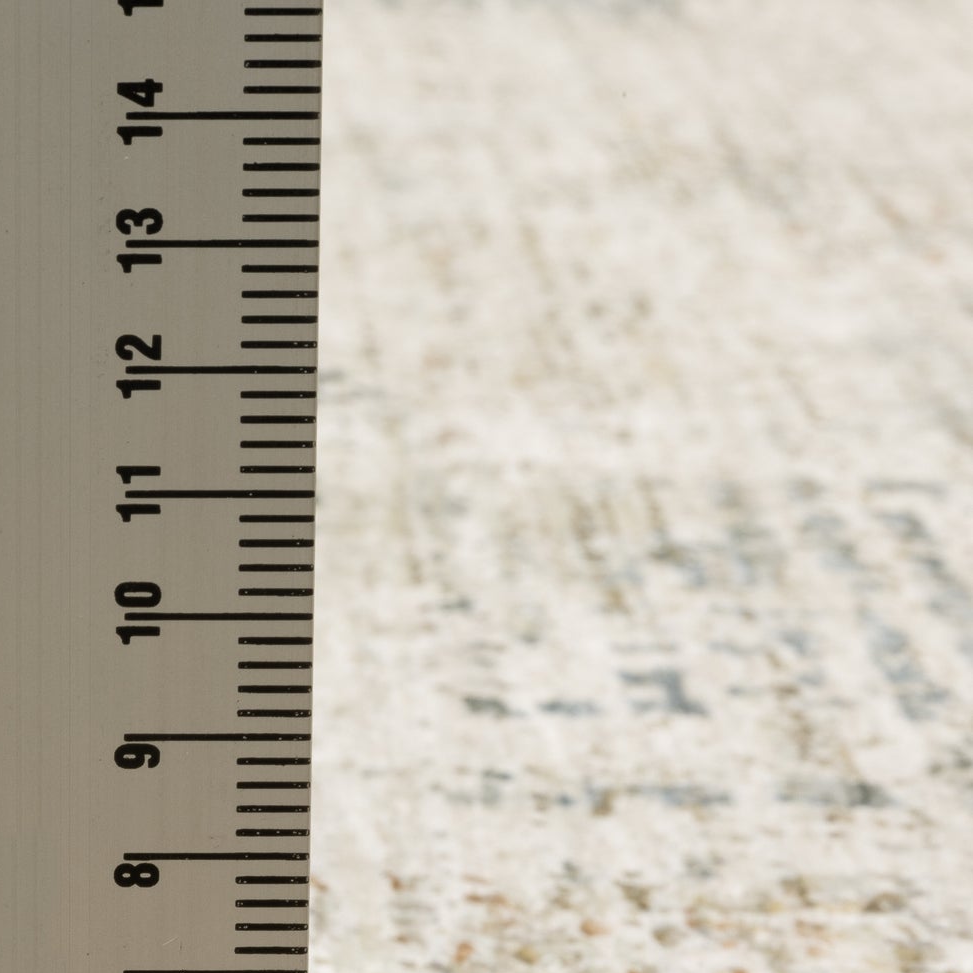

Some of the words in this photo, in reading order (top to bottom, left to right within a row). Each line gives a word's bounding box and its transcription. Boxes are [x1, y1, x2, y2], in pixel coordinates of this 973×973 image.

[116, 78, 164, 146] 14
[115, 207, 164, 274] 13
[114, 334, 162, 400] 12
[115, 465, 162, 523] 11
[113, 581, 162, 646] 10
[113, 742, 161, 770] 9
[113, 862, 160, 888] 8
